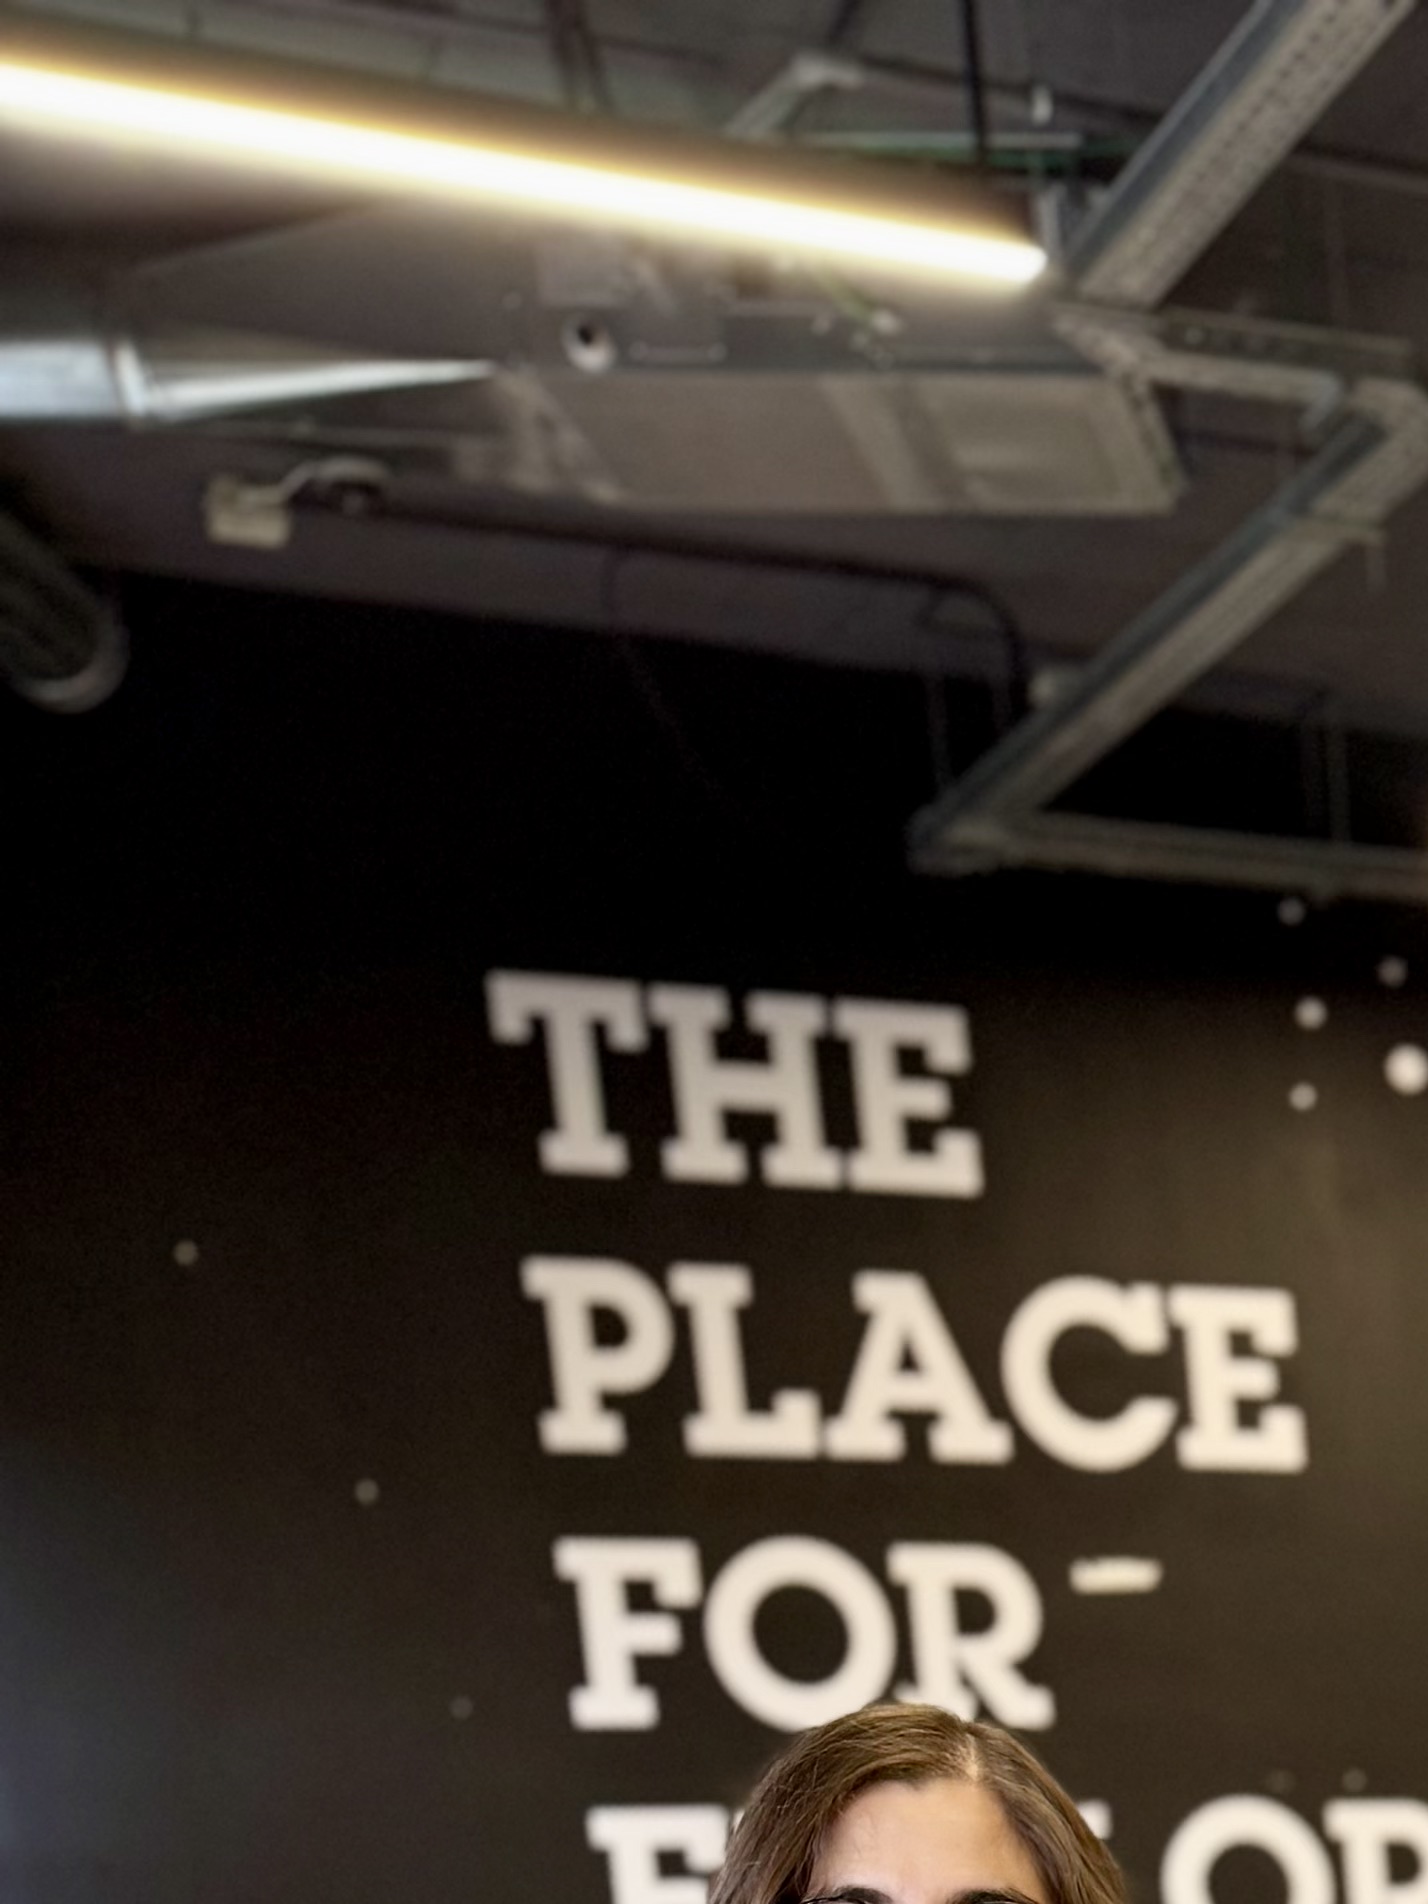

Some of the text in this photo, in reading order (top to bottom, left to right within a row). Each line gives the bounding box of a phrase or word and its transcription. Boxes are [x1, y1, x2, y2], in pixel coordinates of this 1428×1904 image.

[485, 968, 985, 1198] THE
[521, 1254, 1307, 1474] PLACE
[551, 1535, 1056, 1733] FOR
